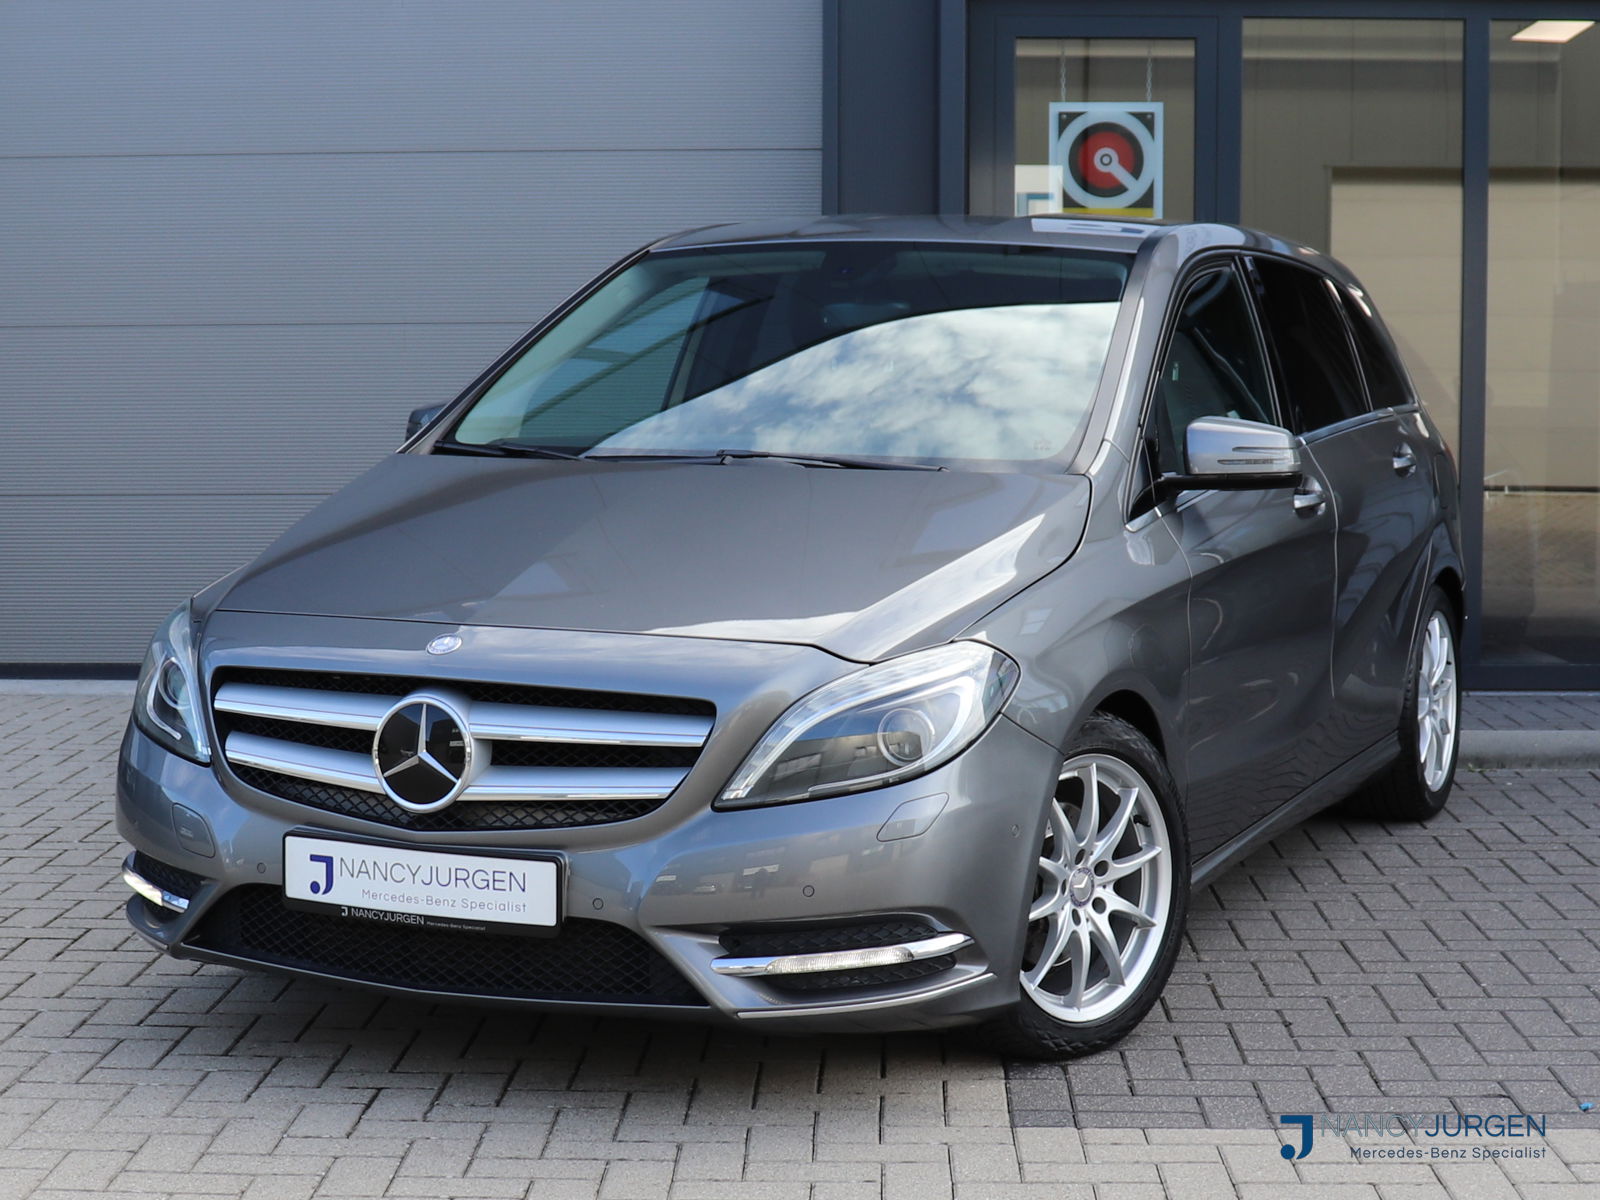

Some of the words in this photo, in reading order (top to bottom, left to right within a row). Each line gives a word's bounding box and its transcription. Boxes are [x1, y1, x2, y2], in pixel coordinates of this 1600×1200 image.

[339, 857, 527, 893] NANCYJURGEN
[361, 888, 457, 908] Mercedes-Benz
[461, 898, 527, 913] Specialist
[351, 907, 425, 926] NANCYJURGEN
